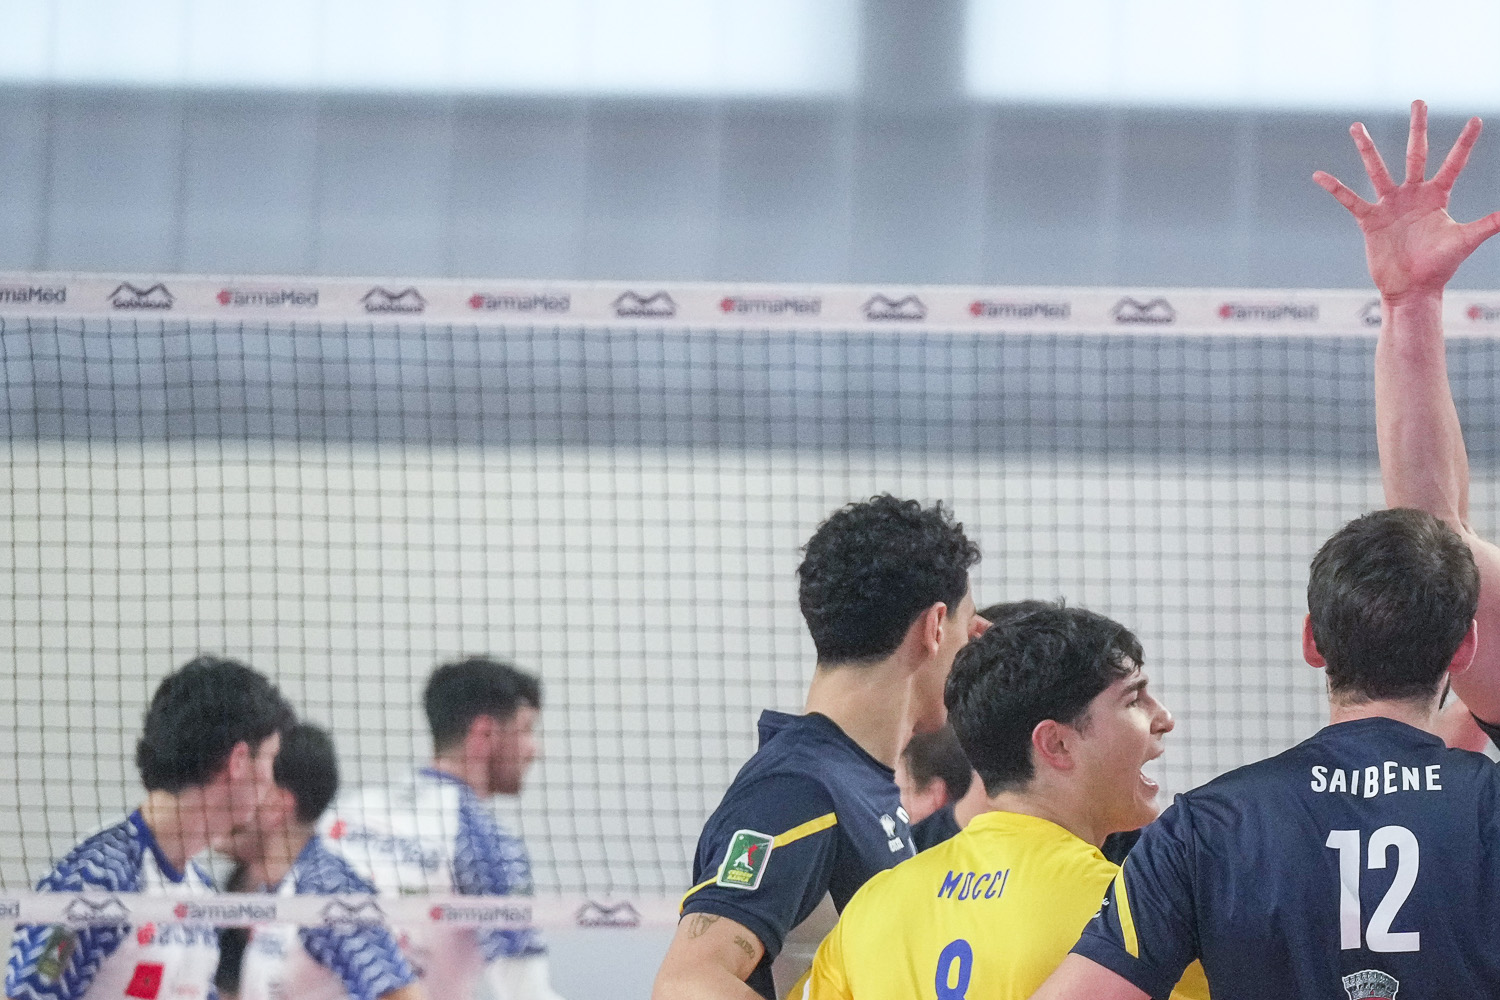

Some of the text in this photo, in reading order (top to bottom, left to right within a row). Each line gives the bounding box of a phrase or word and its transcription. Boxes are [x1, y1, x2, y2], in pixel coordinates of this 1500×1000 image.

[1310, 760, 1442, 799] SAIBENE
[937, 868, 1011, 901] MOCCI
[1325, 825, 1420, 953] 12
